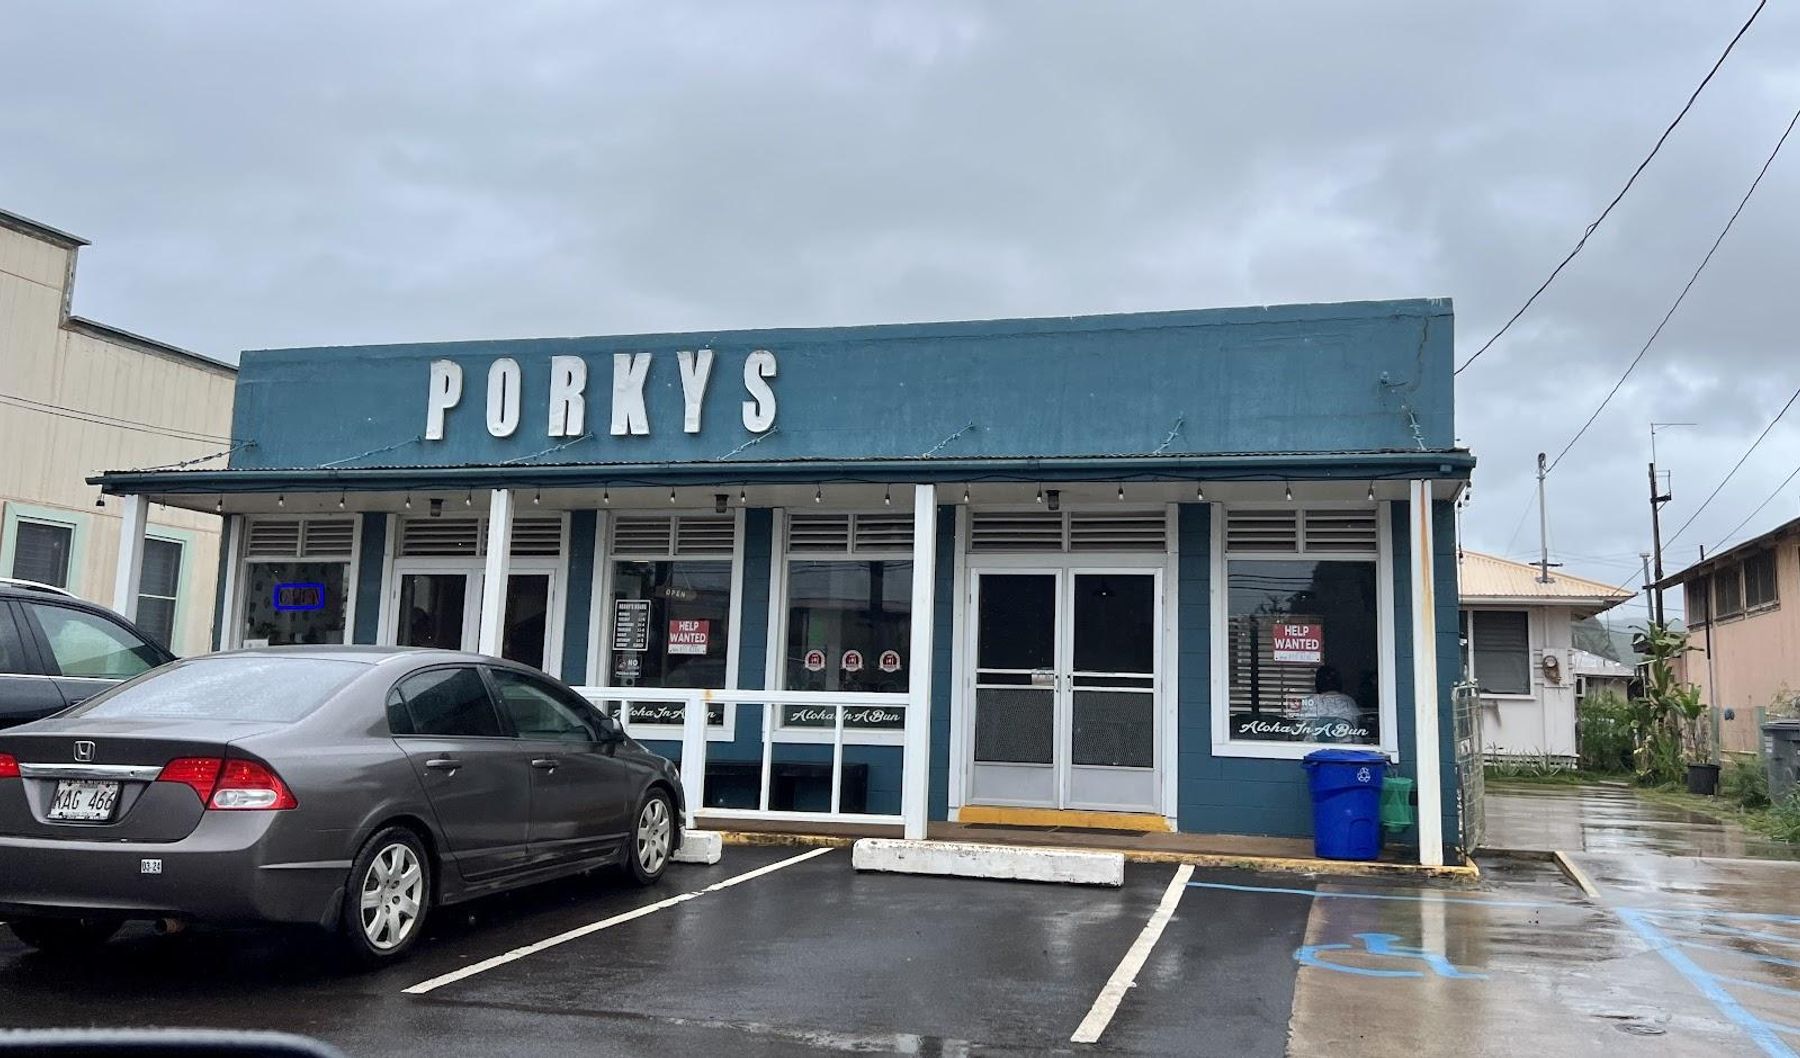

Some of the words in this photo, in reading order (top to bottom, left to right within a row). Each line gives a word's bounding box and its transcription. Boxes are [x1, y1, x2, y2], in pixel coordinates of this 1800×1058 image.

[425, 350, 777, 440] PORKYS
[665, 588, 686, 598] OPEN
[678, 621, 699, 632] HELP
[1284, 625, 1309, 637] HELP
[669, 632, 706, 643] WANTED
[1274, 638, 1320, 650] WANTED
[790, 708, 836, 722] Aloha
[853, 709, 870, 722] A
[869, 709, 901, 722] Bun
[1239, 720, 1291, 733] Aloha
[1290, 722, 1313, 735] In
[1312, 723, 1332, 736] A
[1331, 723, 1369, 738] Bun
[56, 789, 82, 810] KAG
[88, 790, 116, 810] 466
